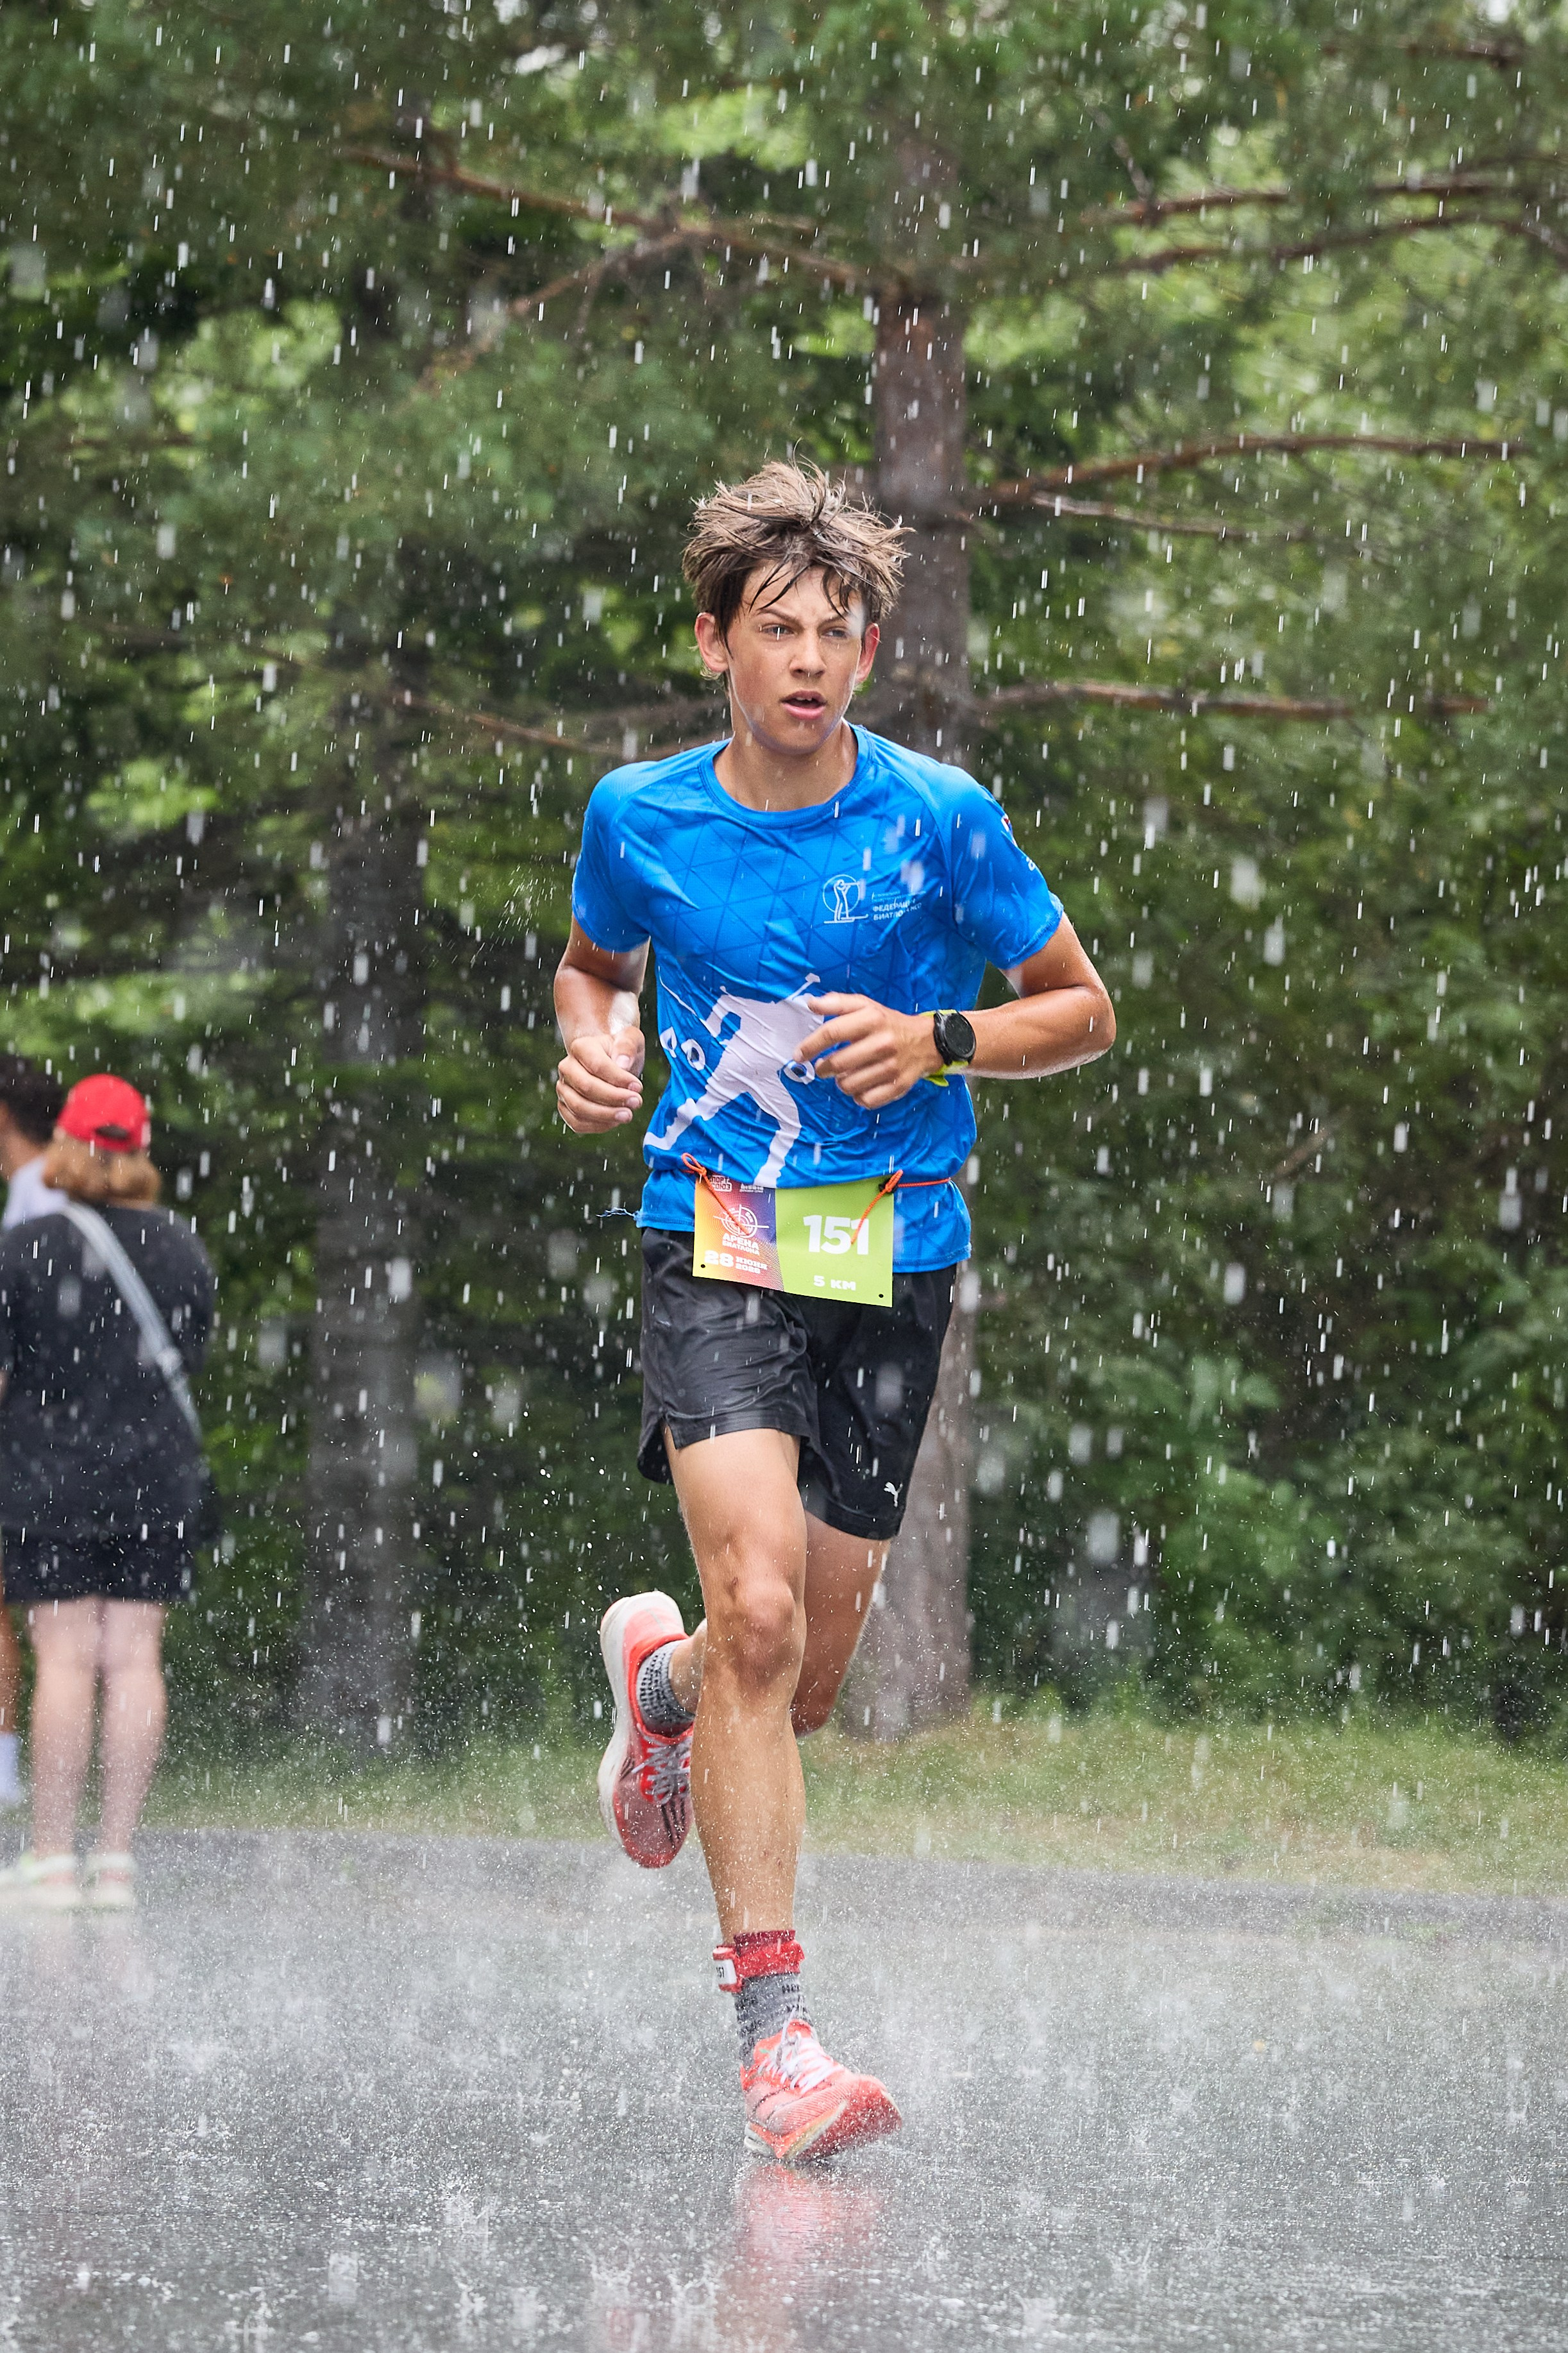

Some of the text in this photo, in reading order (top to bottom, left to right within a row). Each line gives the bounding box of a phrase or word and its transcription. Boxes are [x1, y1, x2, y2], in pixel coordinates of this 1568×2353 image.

[723, 1232, 759, 1250] АРЕНА
[803, 1214, 869, 1255] 151
[704, 1250, 734, 1268] 28
[813, 1275, 856, 1291] 5 КМ
